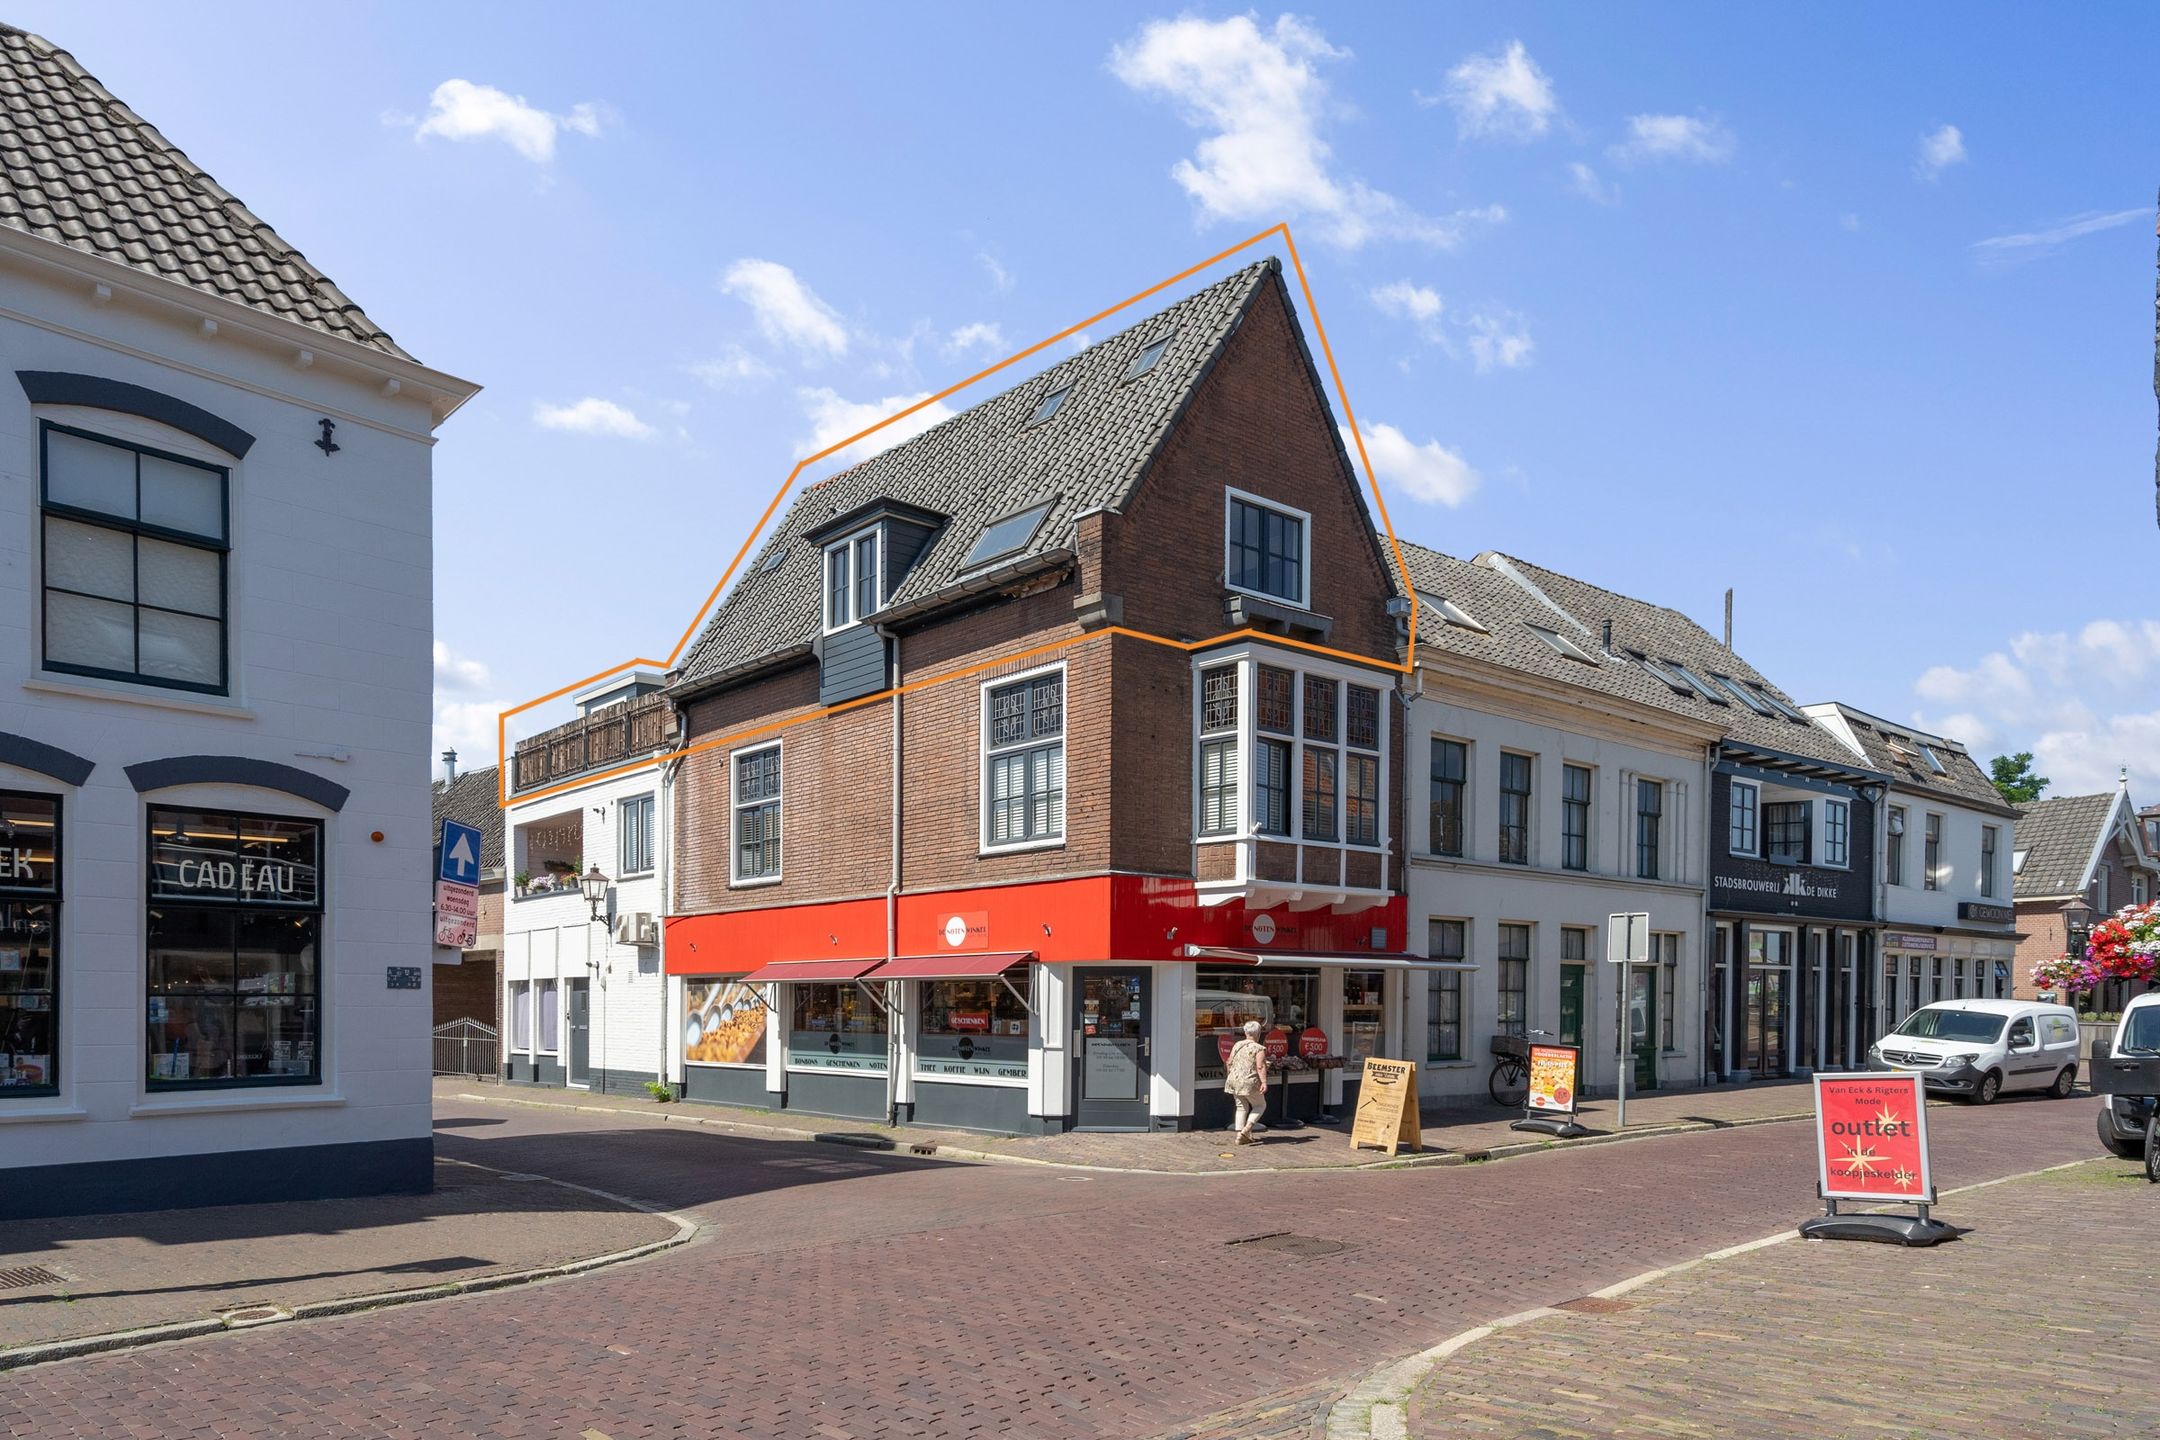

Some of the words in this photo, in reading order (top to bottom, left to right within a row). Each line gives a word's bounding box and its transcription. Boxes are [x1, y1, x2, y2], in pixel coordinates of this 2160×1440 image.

[180, 859, 294, 894] CADEAU
[443, 885, 474, 896] uitgezonderd
[1714, 875, 1780, 893] STADSBROUWERIJ
[1806, 886, 1815, 896] DE
[1817, 887, 1837, 898] DIKKE
[447, 896, 469, 907] woensdag
[440, 916, 475, 928] uitgezonderd
[946, 927, 965, 935] NOTEN
[966, 925, 986, 934] WINKEL
[1254, 925, 1275, 933] NOTEN
[950, 1016, 986, 1026] GESCHENKEN
[826, 1060, 860, 1068] GESCHENKEN
[1367, 1062, 1406, 1074] BEEMSTER
[943, 1066, 966, 1074] KOFFIE
[974, 1067, 990, 1075] WIJN
[998, 1068, 1026, 1077] GEMBER
[1828, 1086, 1846, 1094] Van
[1848, 1086, 1864, 1094] Eck
[1866, 1086, 1872, 1094] &
[1875, 1086, 1909, 1095] Rigters
[1855, 1097, 1881, 1105] Mode
[1831, 1118, 1911, 1137] outlet
[1862, 1147, 1876, 1156] de
[1830, 1167, 1917, 1180] koopjeskelder
